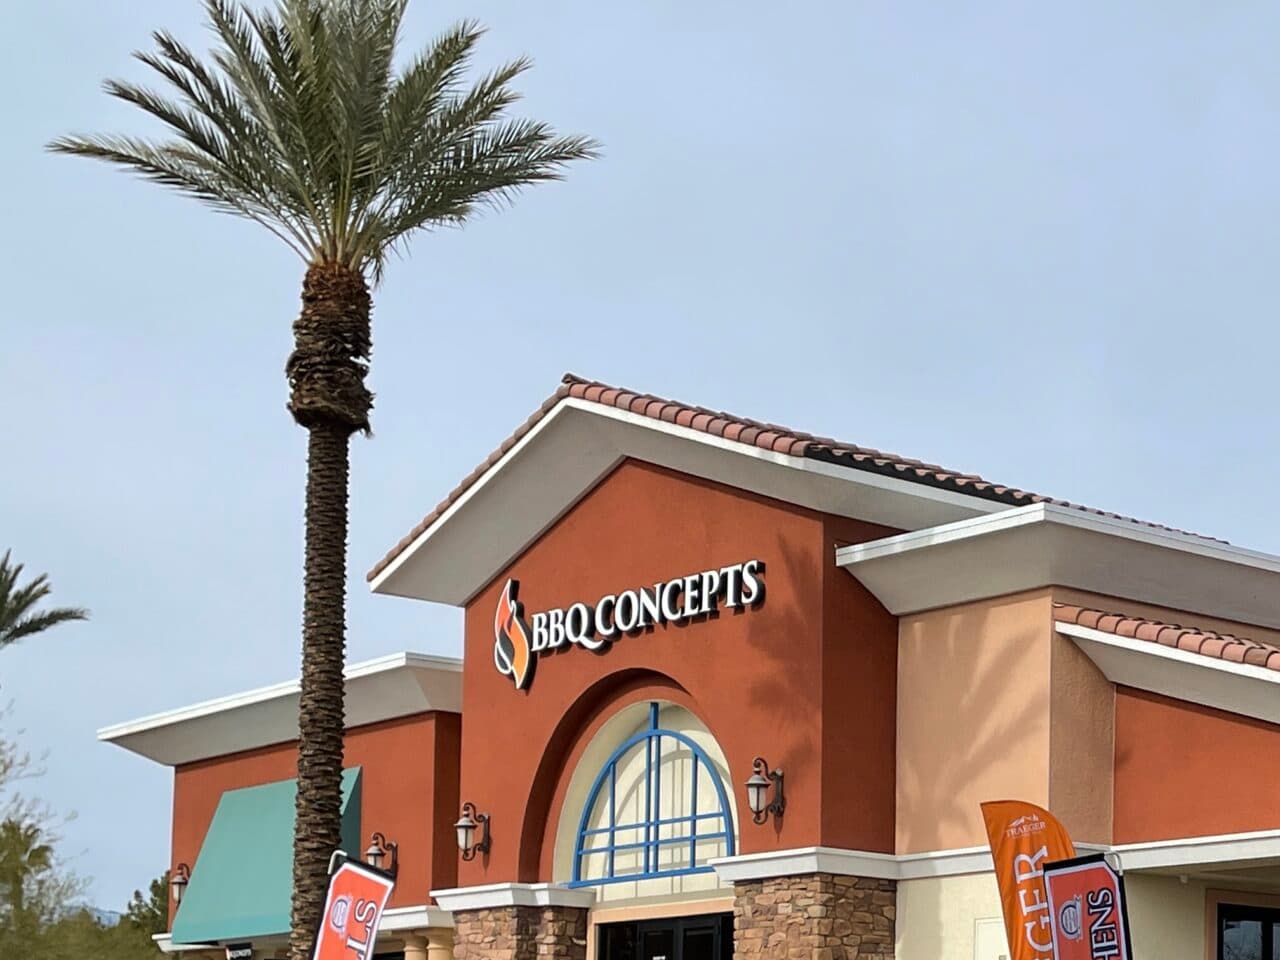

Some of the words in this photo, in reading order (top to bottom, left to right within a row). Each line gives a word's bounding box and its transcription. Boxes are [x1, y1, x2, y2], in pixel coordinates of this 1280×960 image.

[531, 602, 605, 652] BBQ
[595, 560, 760, 635] CONCEPTS
[1006, 820, 1046, 839] TRAEGER
